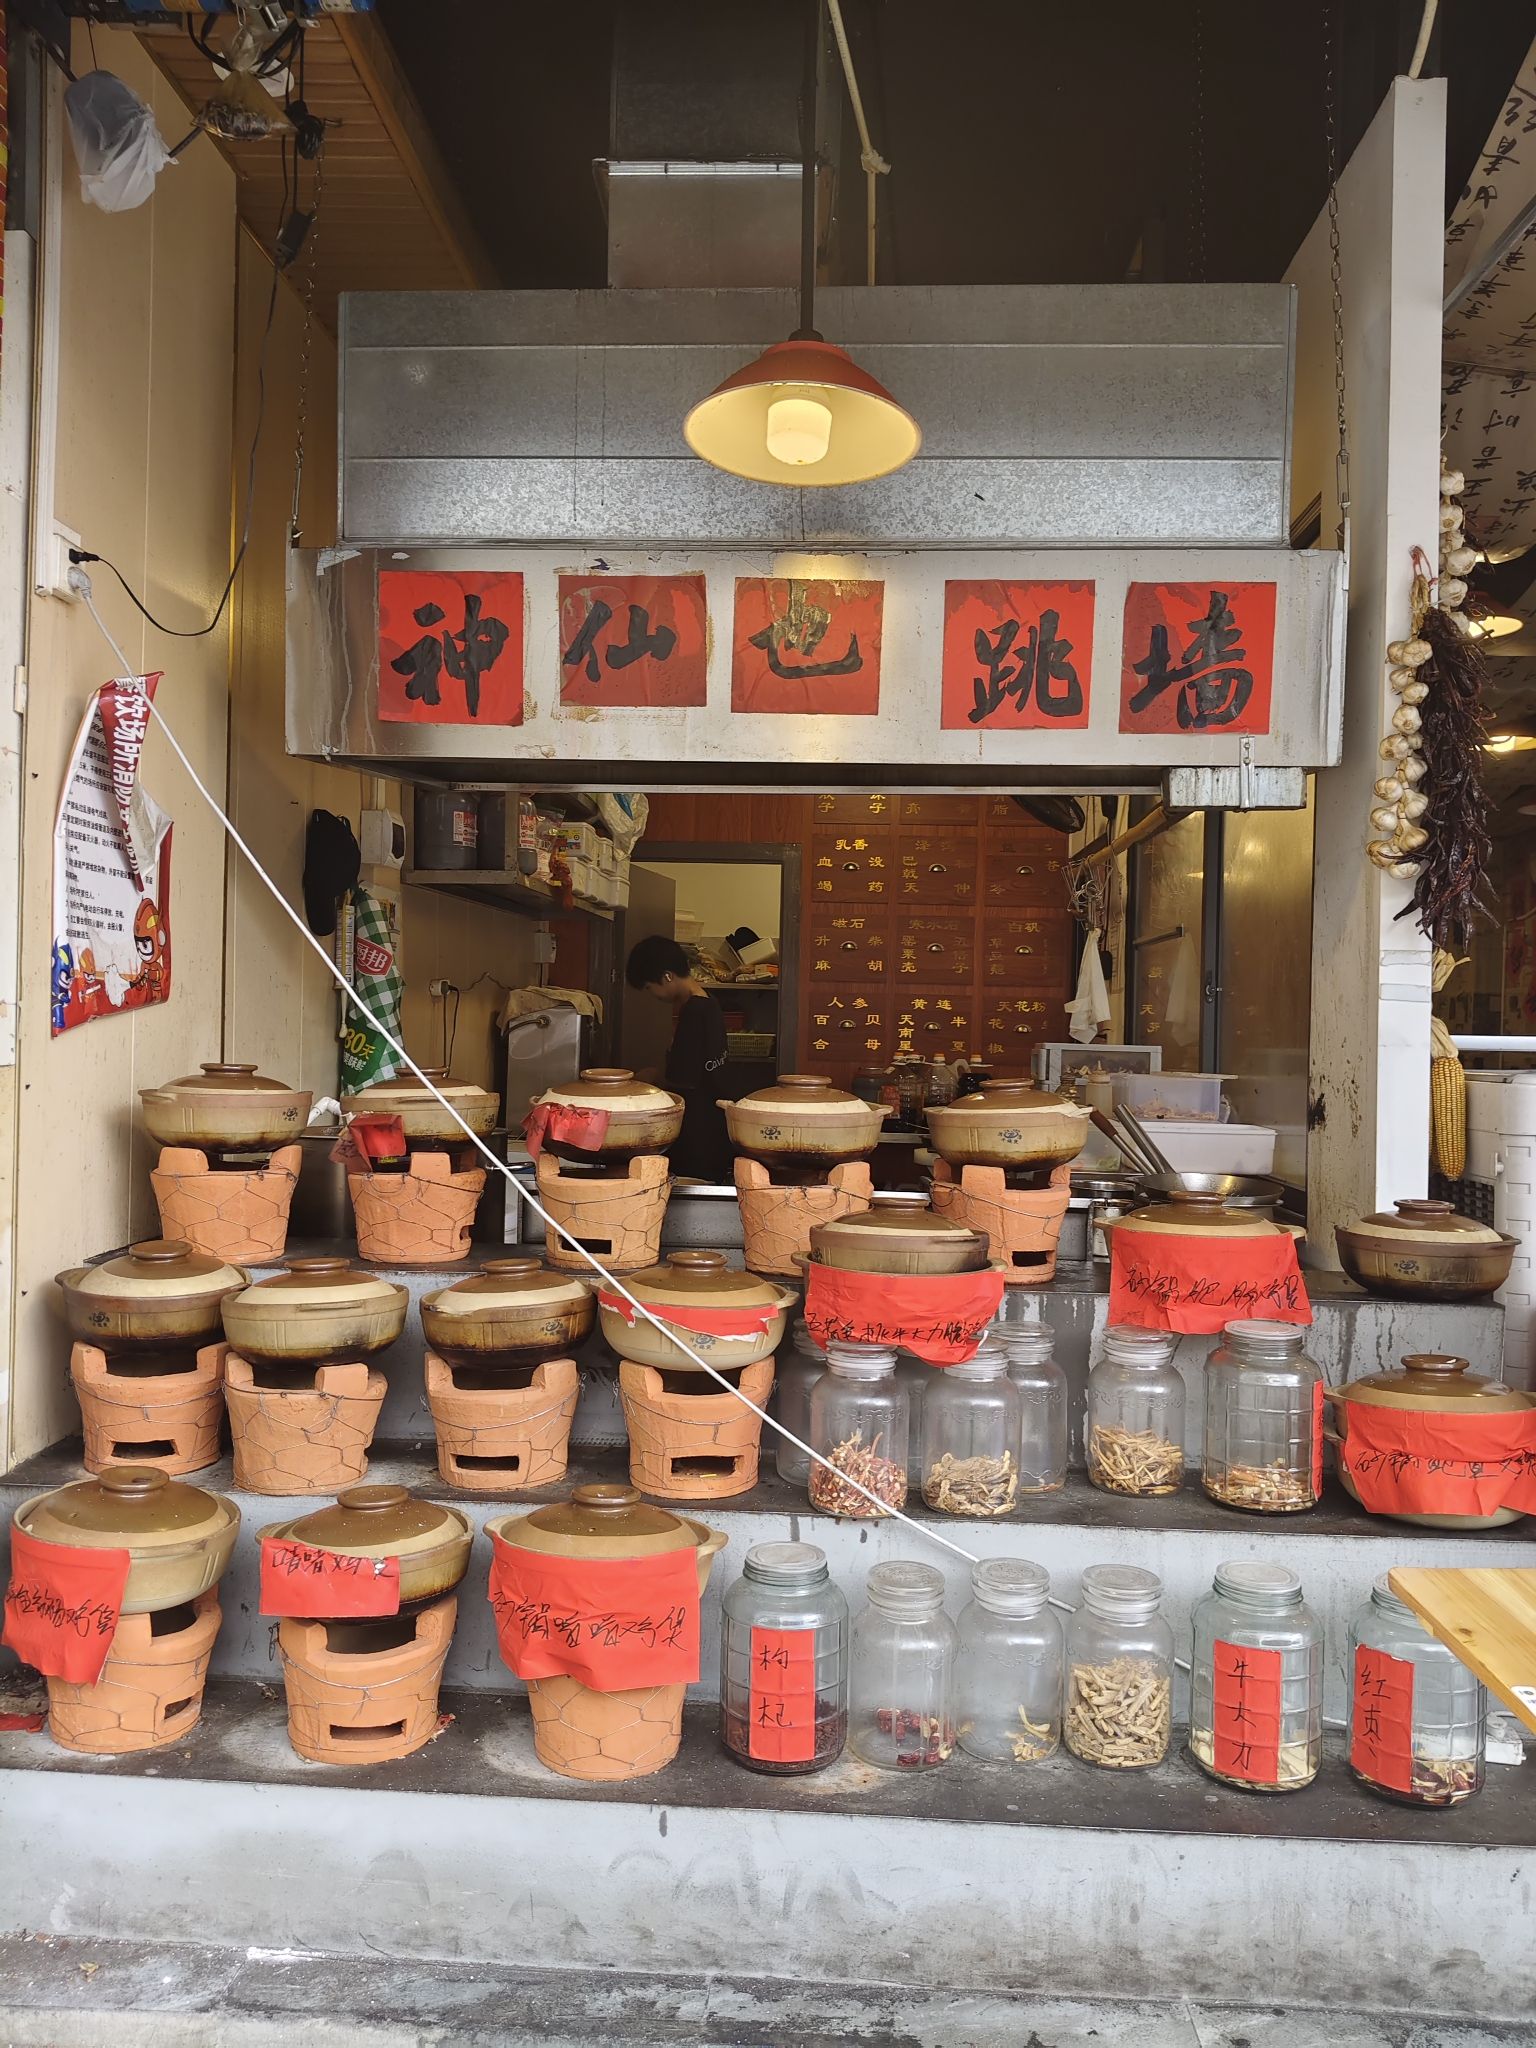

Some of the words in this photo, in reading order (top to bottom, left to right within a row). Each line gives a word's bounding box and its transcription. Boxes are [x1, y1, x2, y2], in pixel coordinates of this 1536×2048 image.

[389, 580, 1253, 729] 神仙也跳墙
[835, 839, 869, 851] 乳香
[816, 857, 833, 892] 血竭
[868, 857, 885, 893] 没药
[831, 918, 865, 930] 磁石
[815, 935, 832, 971] 升麻
[867, 935, 884, 972] 柴胡
[827, 997, 869, 1009] 人参
[911, 998, 953, 1010] 黄连
[997, 1001, 1047, 1013] 天花粉
[813, 1014, 830, 1051] 百合
[864, 1015, 881, 1050] 贝母
[898, 1014, 915, 1052] 天南星
[757, 1644, 793, 1729] 枸杞
[1225, 1657, 1257, 1771] 牛大力
[1360, 1663, 1392, 1759] 红枣
